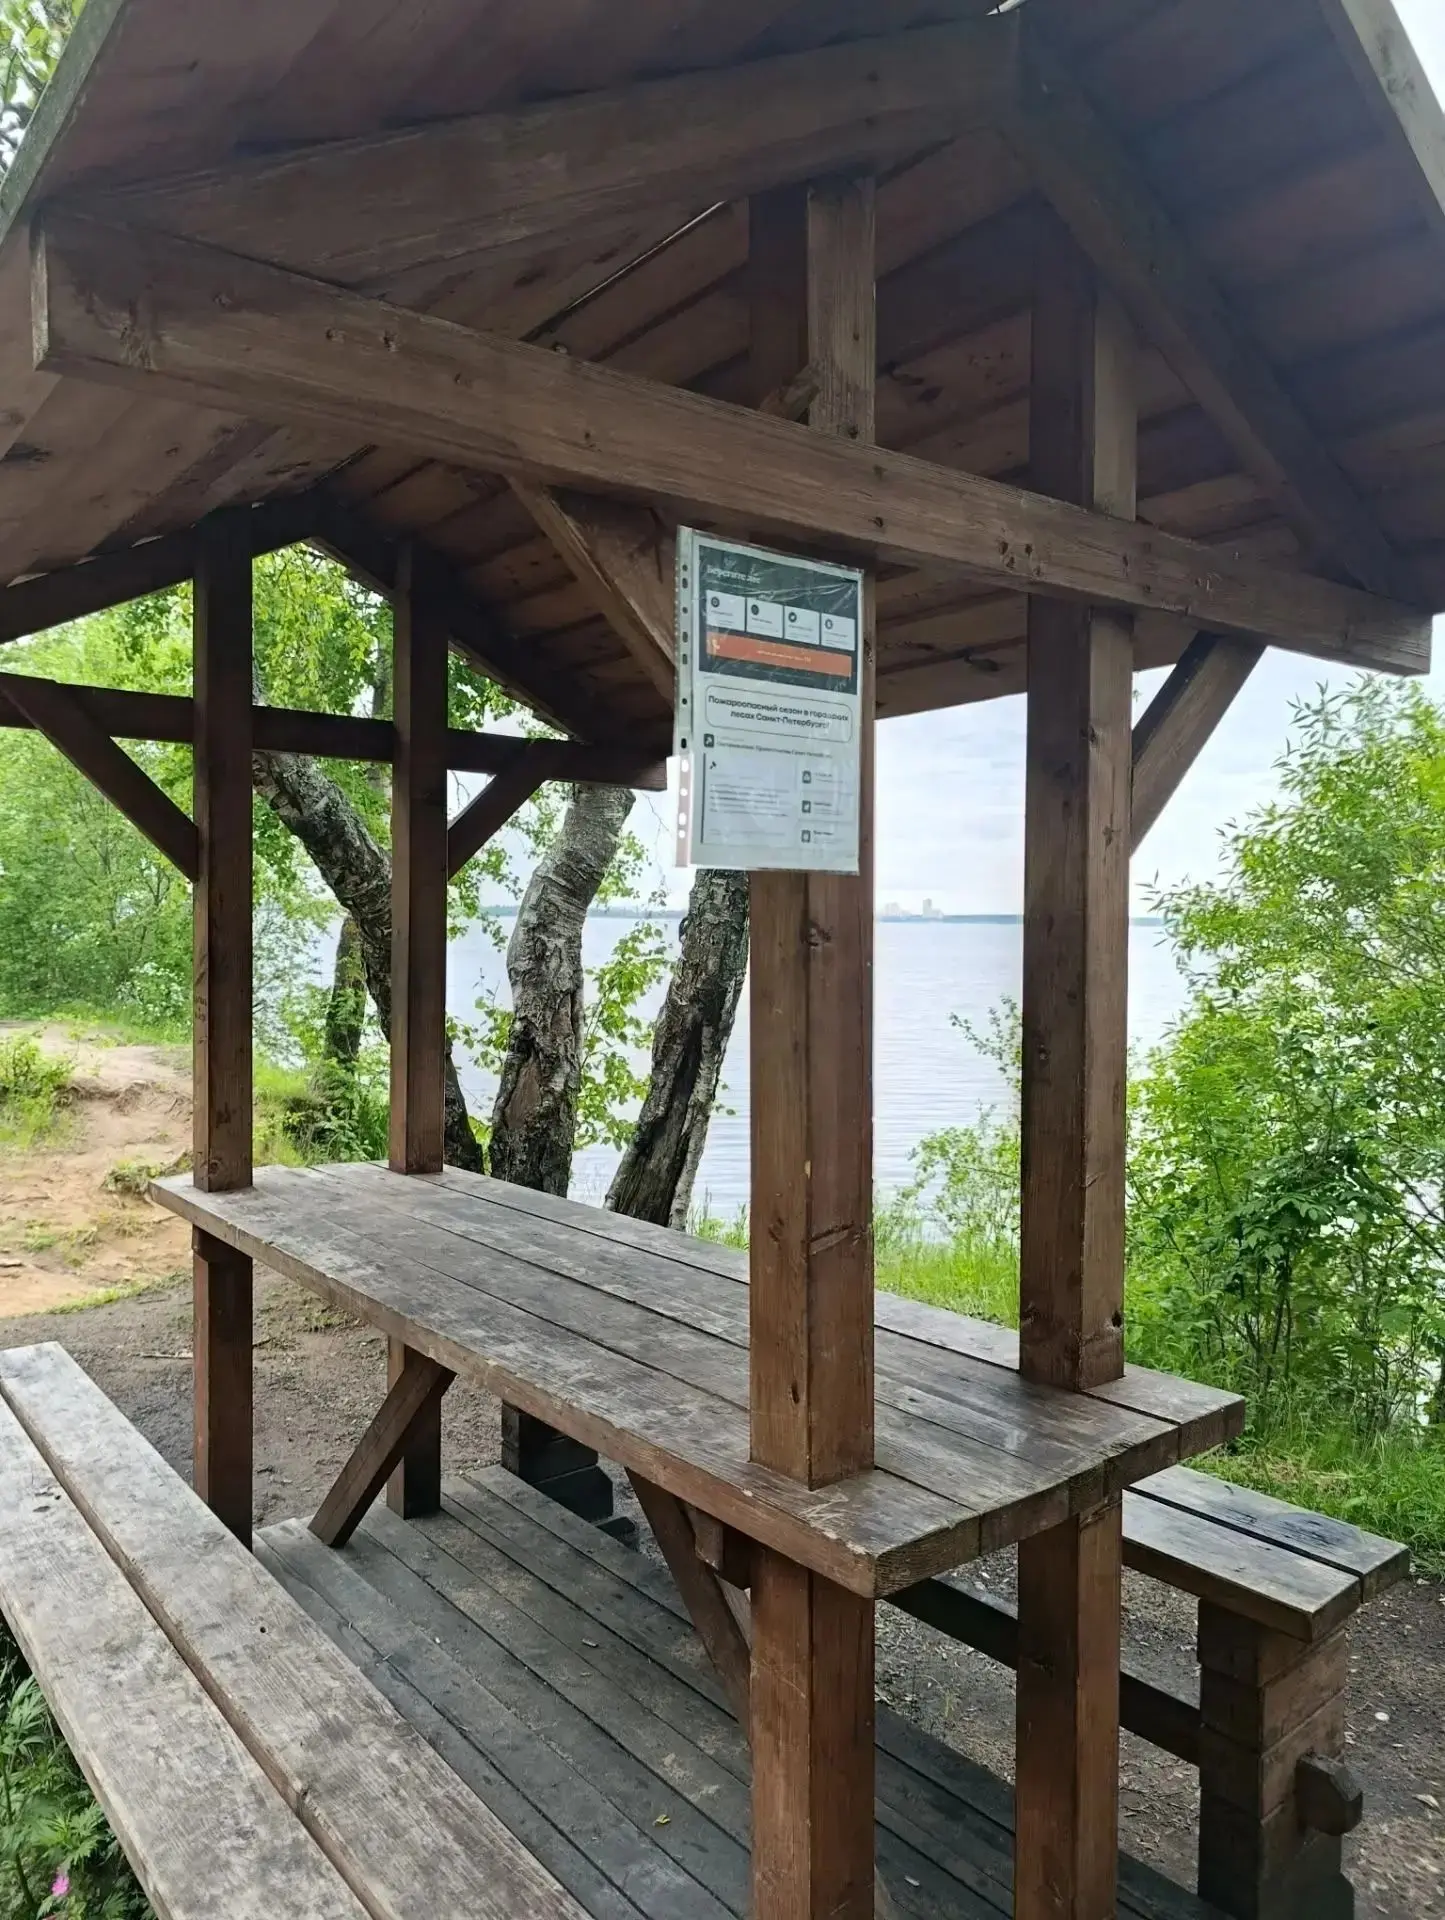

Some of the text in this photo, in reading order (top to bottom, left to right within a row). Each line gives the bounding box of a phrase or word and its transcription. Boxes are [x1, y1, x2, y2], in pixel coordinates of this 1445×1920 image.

[708, 695, 778, 712] Пожароопасный
[779, 706, 802, 715] сезон
[730, 710, 754, 719] лесах
